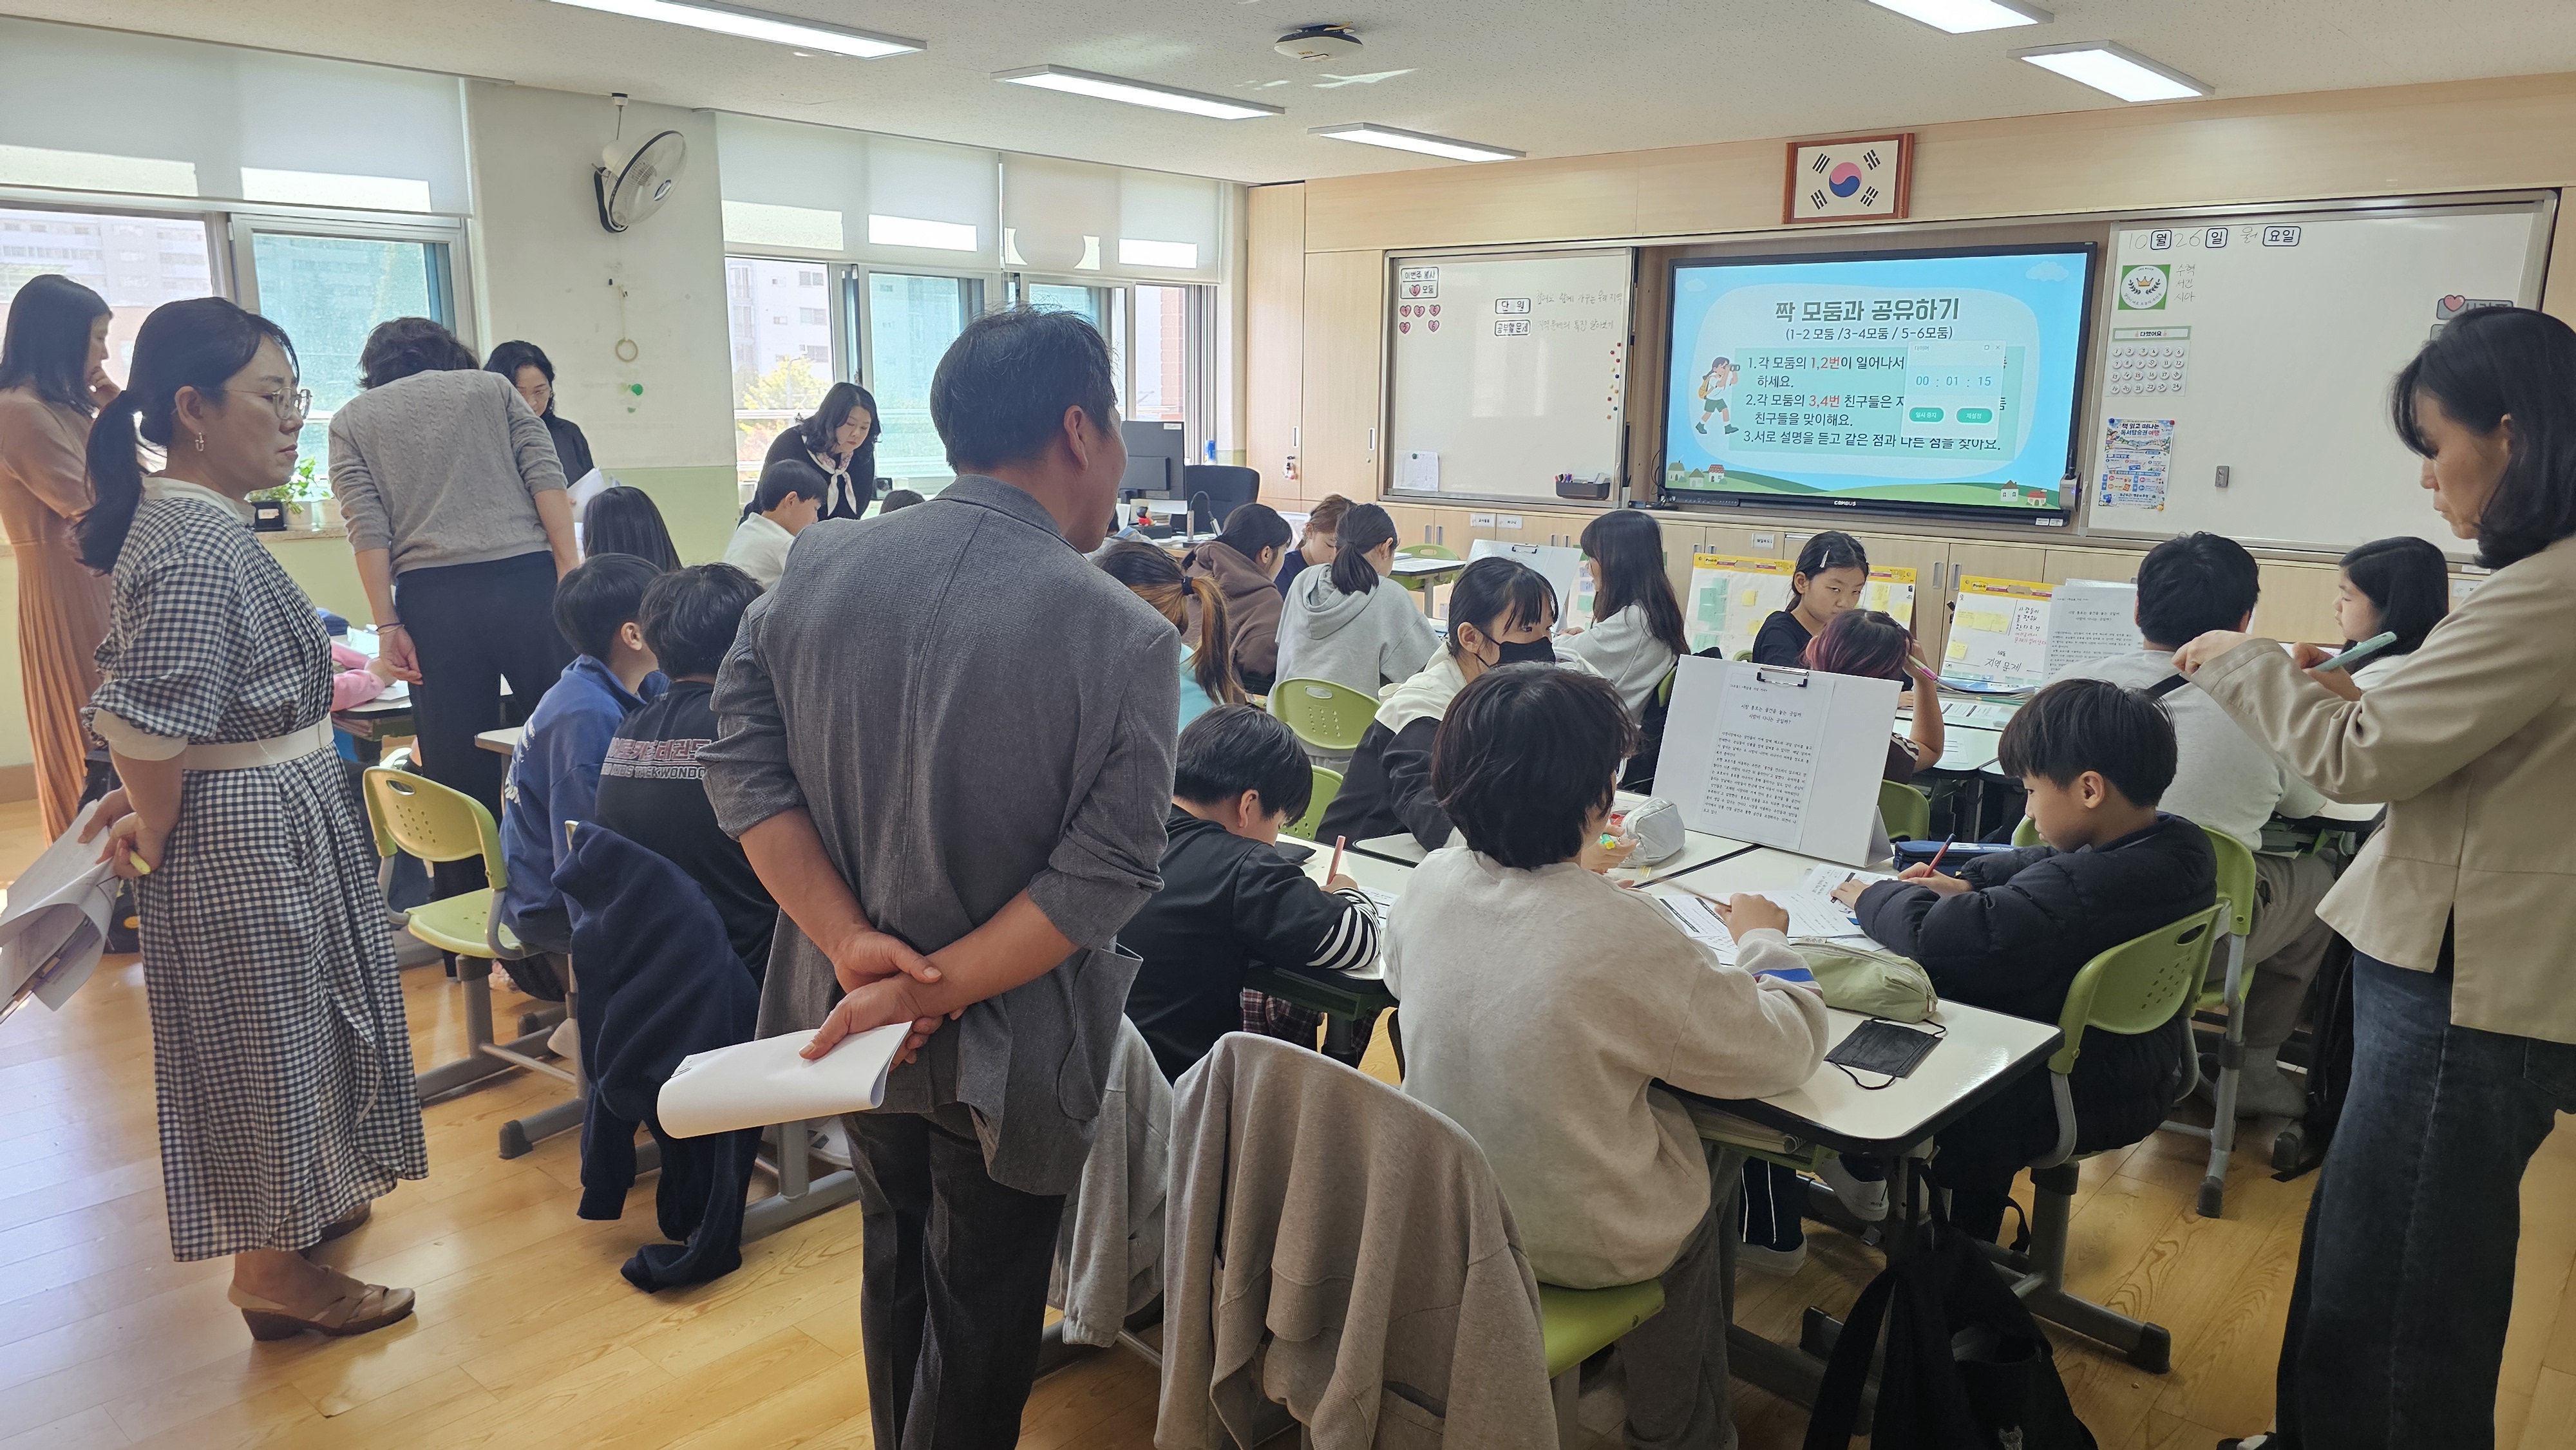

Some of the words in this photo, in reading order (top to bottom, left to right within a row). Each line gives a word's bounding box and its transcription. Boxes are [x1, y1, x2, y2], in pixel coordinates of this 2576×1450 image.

[2128, 233, 2148, 250] 10
[2155, 233, 2167, 247] 월
[2174, 229, 2203, 247] 26
[2211, 231, 2223, 245] 일
[2268, 229, 2295, 243] 요일
[1776, 301, 1795, 323] 짝
[1801, 300, 1865, 322] 모둠과
[1871, 297, 1959, 321] 공유하기
[1785, 328, 1810, 341] (1-2
[1812, 328, 1835, 340] 모둠
[1837, 327, 1889, 341] /3-4모둠
[1901, 326, 1953, 339] 5-6모둠)
[1772, 356, 1807, 370] 모둠의
[1810, 356, 1852, 371] 1,2번이
[1856, 356, 1906, 370] 일어나서
[1757, 375, 1794, 388] 하세요.
[1915, 375, 1930, 386] 00
[1946, 376, 1958, 386] 01
[1978, 376, 1992, 386] 15
[1770, 393, 1805, 407] 모둠의
[1808, 395, 1841, 408] 3,4번
[1844, 394, 1893, 408] 친구들은
[1754, 411, 1801, 426] 친구들을
[1803, 413, 1853, 427] 맞이해요.
[1779, 431, 1815, 444] 설명을
[1817, 432, 1841, 445] 듣고
[1844, 433, 1869, 446] 같은
[1872, 433, 1897, 447] 점과
[1984, 658, 2002, 668] 지역
[2002, 662, 2022, 672] 문제
